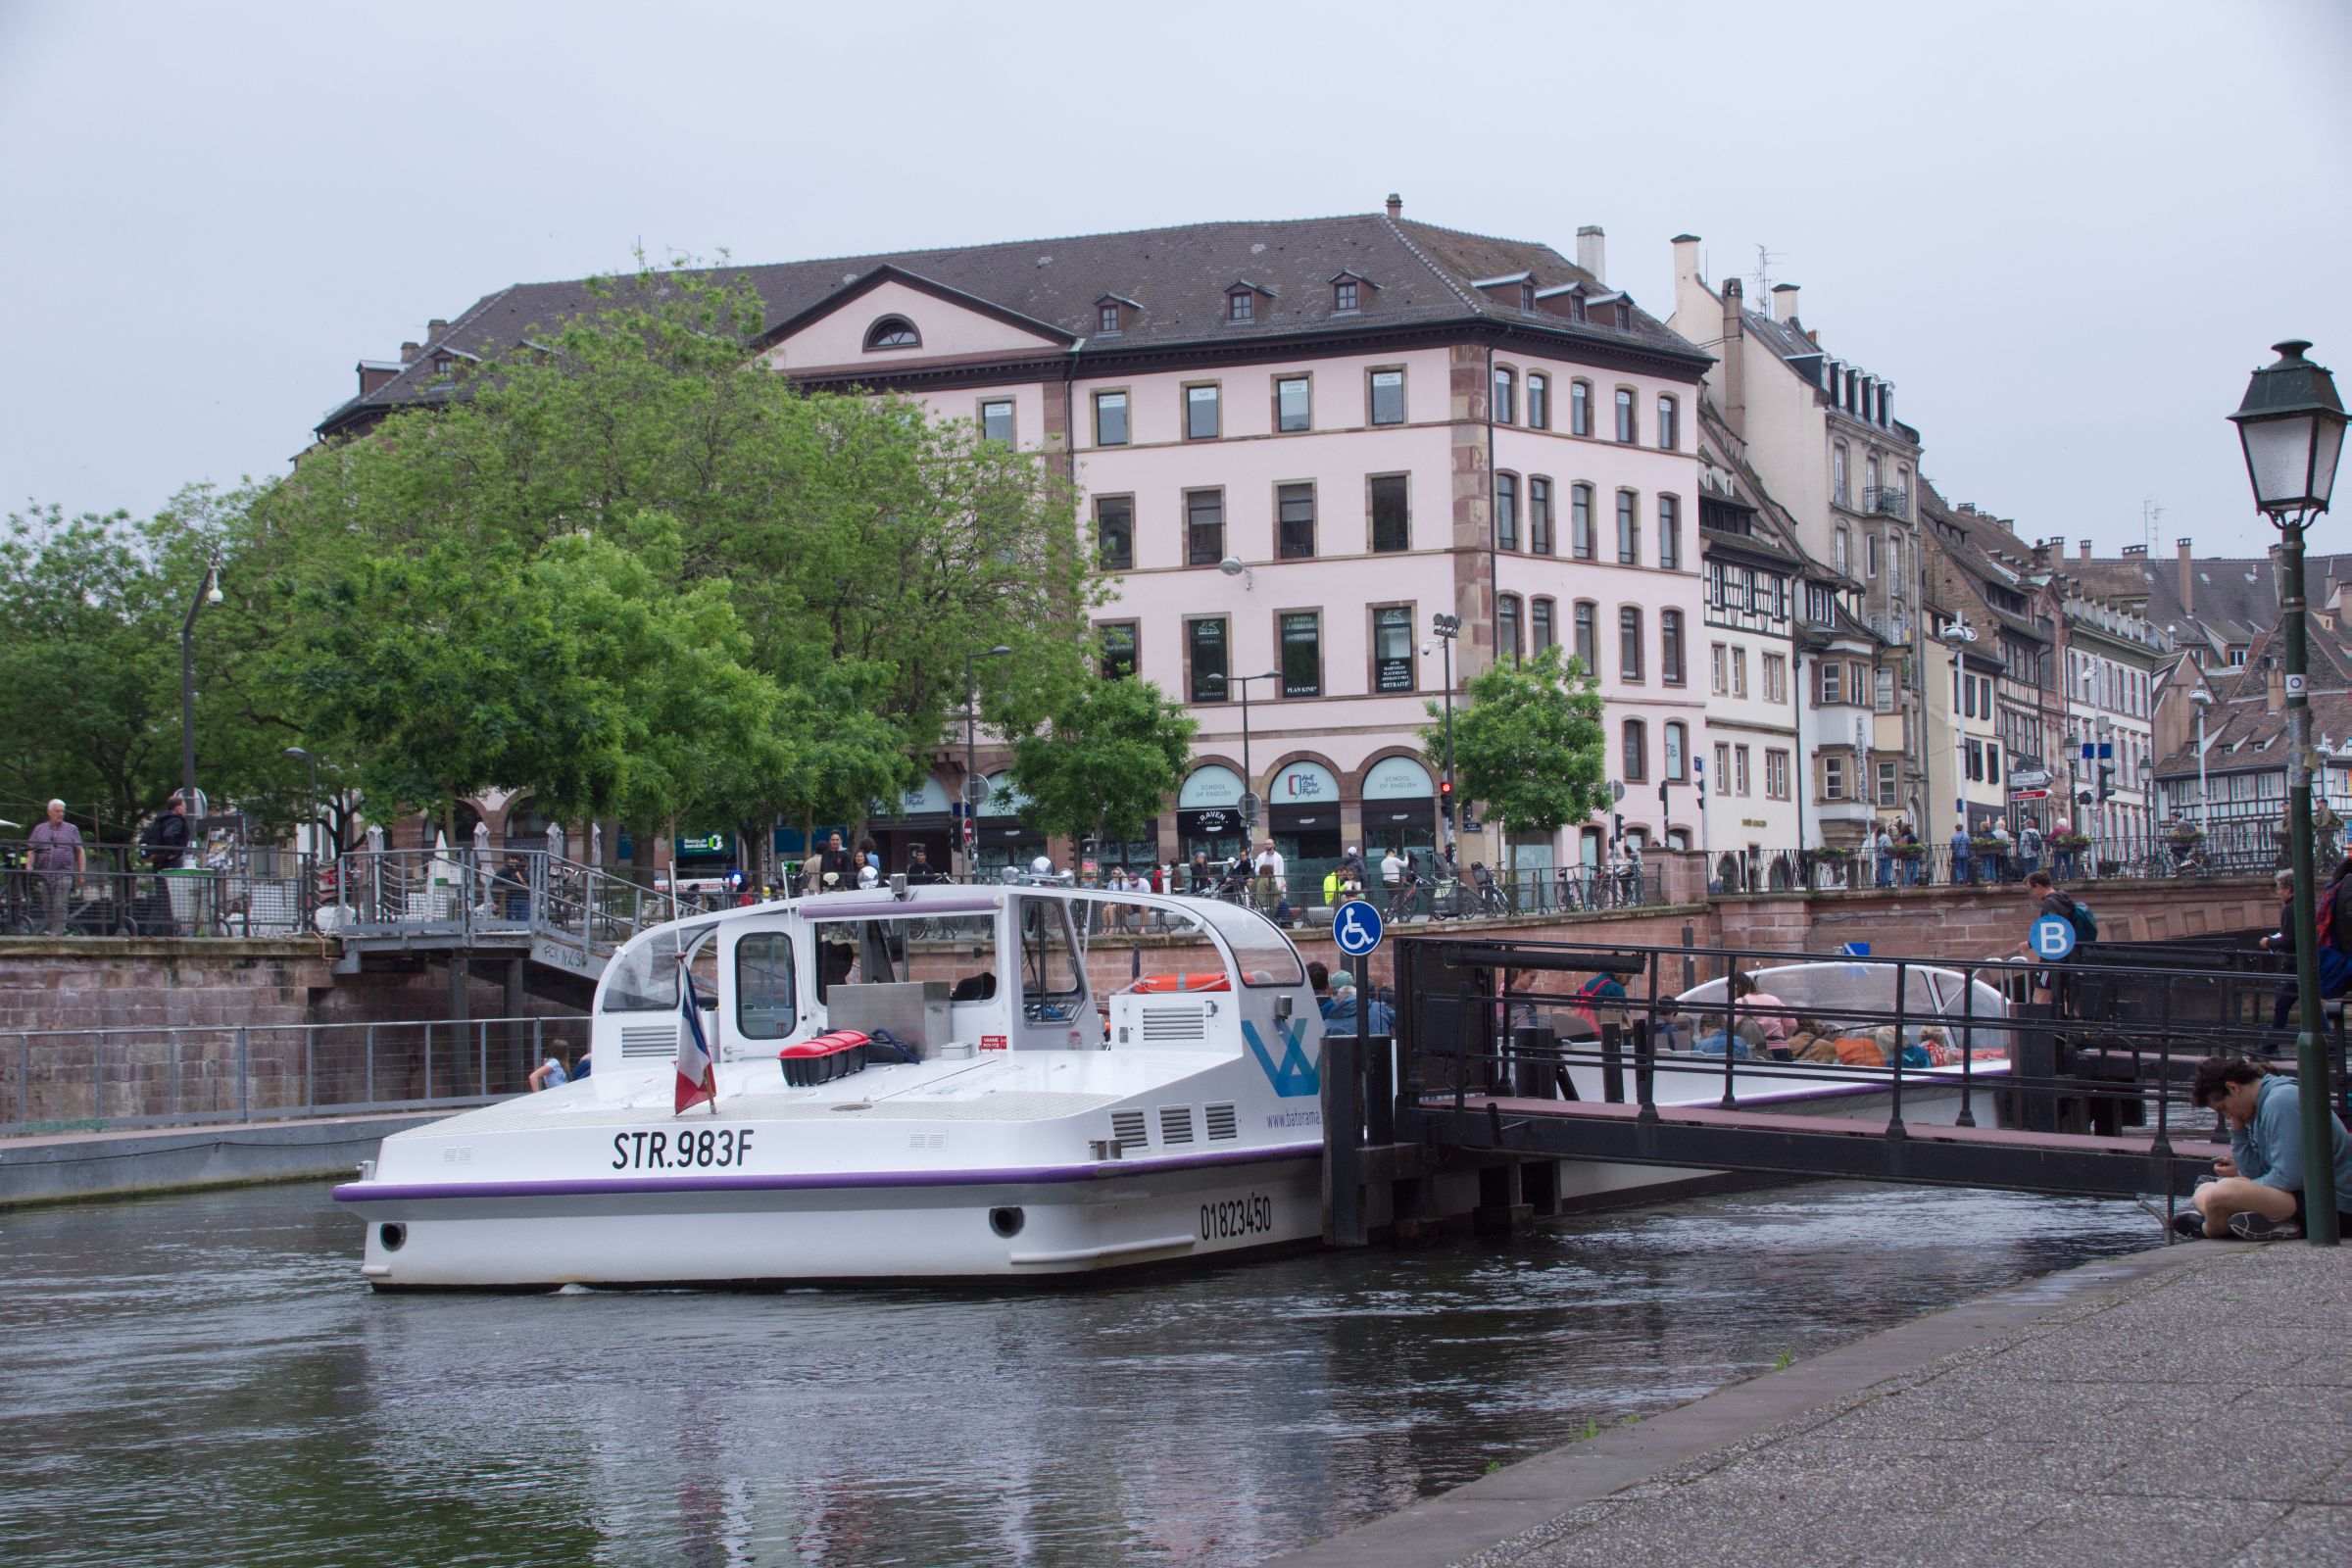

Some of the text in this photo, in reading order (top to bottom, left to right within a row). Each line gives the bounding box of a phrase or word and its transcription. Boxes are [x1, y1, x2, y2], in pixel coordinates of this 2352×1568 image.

[1200, 811, 1226, 821] RAVEN
[2040, 922, 2067, 954] B
[612, 1129, 755, 1170] STR.983F
[1200, 1195, 1271, 1241] 01823450
